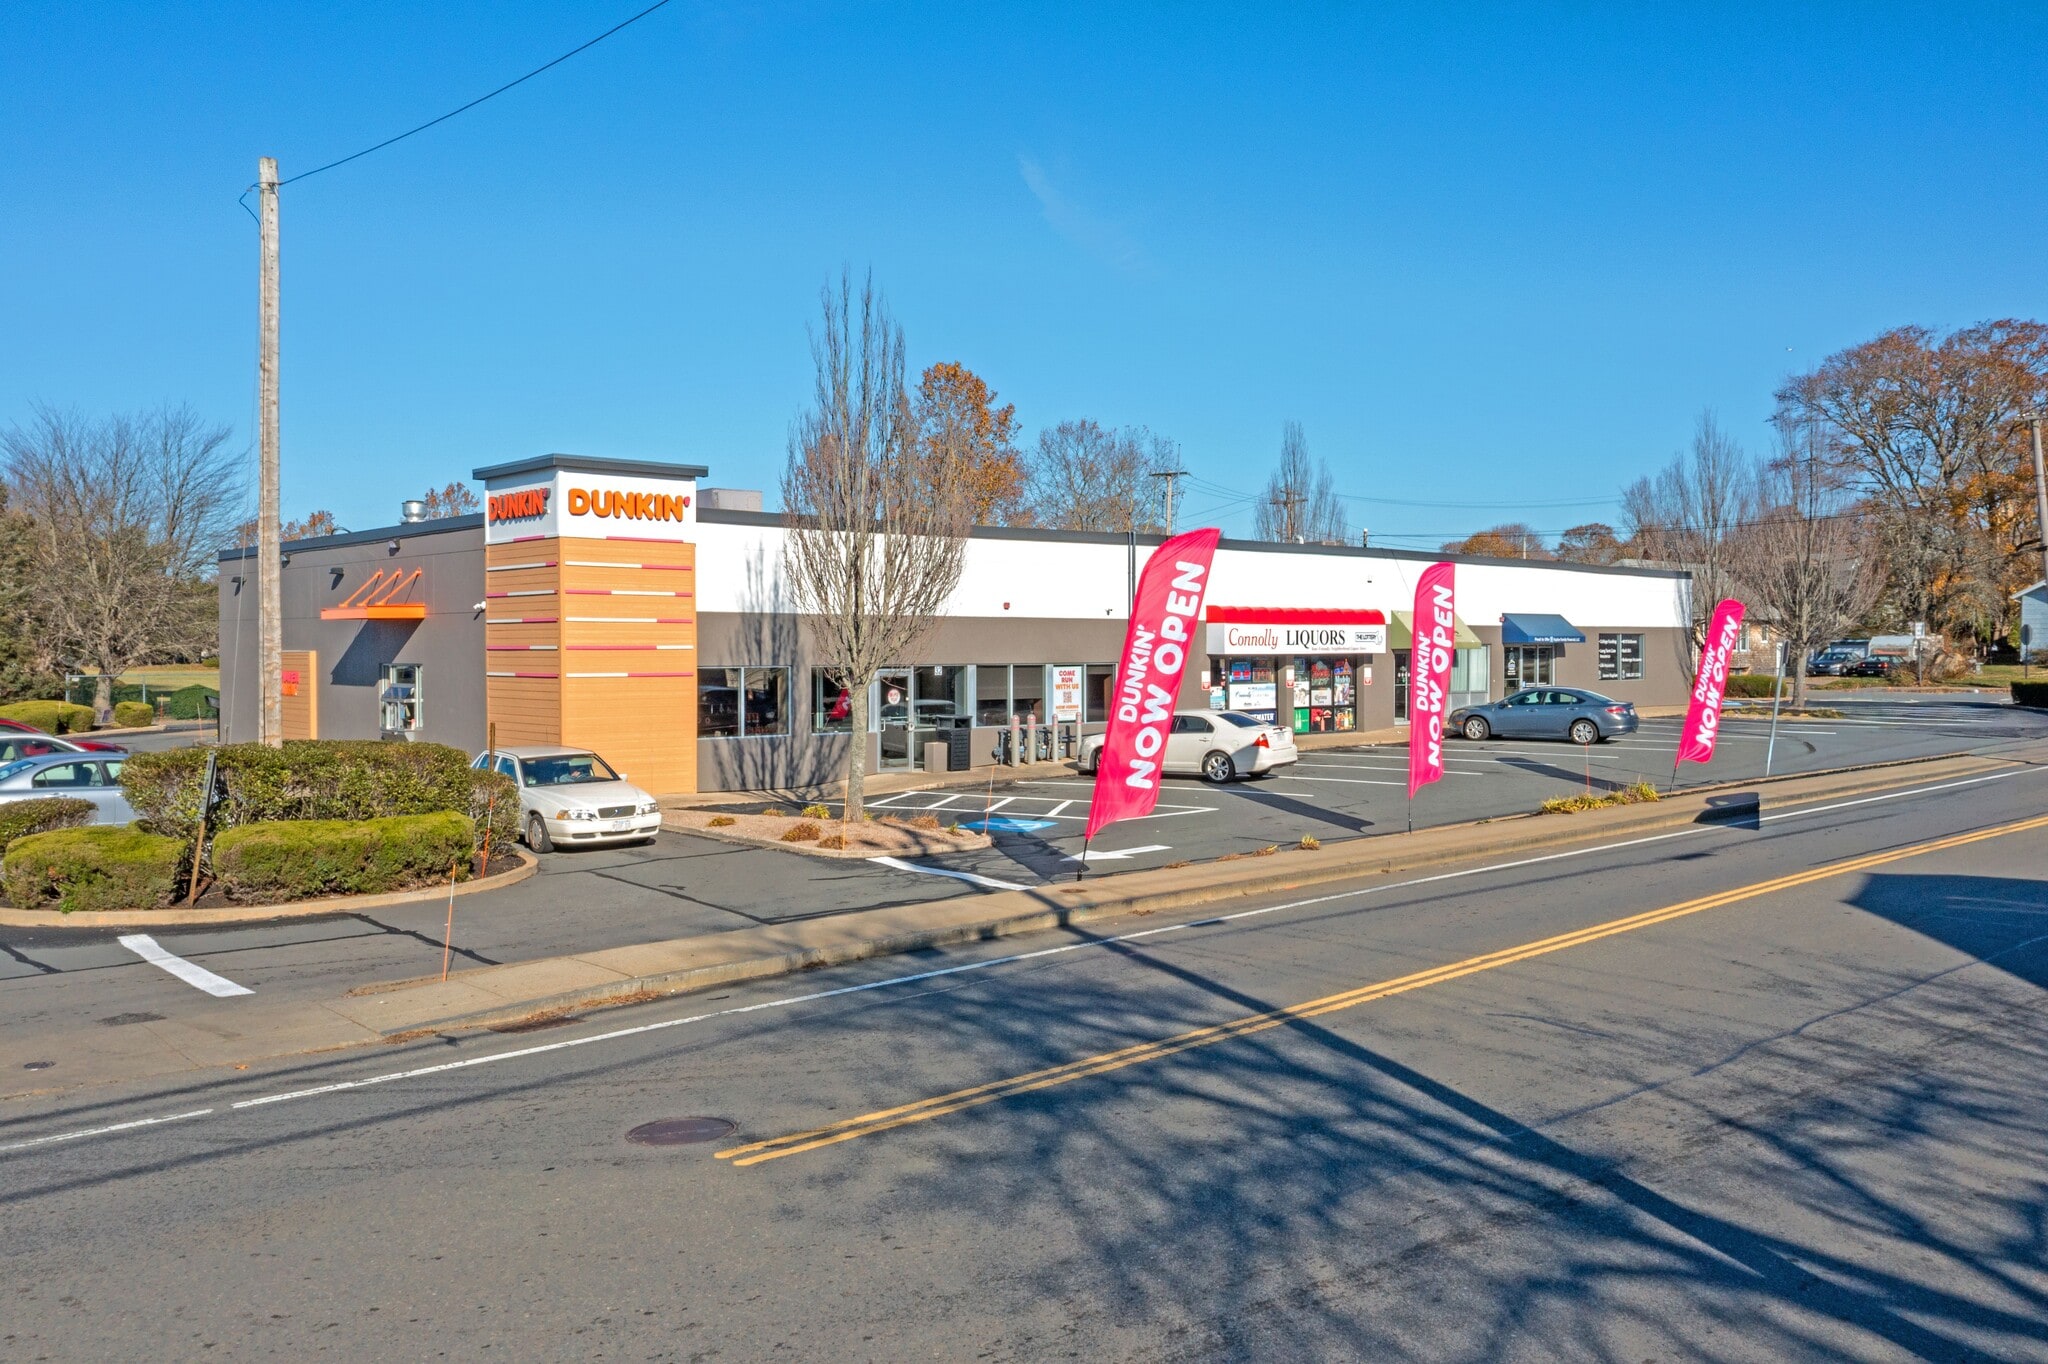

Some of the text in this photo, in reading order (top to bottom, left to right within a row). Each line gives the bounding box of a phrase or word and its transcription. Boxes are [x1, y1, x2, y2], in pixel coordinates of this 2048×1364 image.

[488, 487, 548, 521] DUNKIN'
[568, 488, 691, 522] DUNKIN'
[1118, 624, 1156, 723] DUNKIN'
[1125, 560, 1206, 790] NOW OPEN
[1228, 627, 1346, 650] Connolly LIQUORS
[1416, 631, 1431, 711] DUNKIN'
[1428, 584, 1453, 767] NOW OPEN
[1695, 643, 1716, 702] DUNKIN'
[1695, 615, 1739, 748] NOW OPEN
